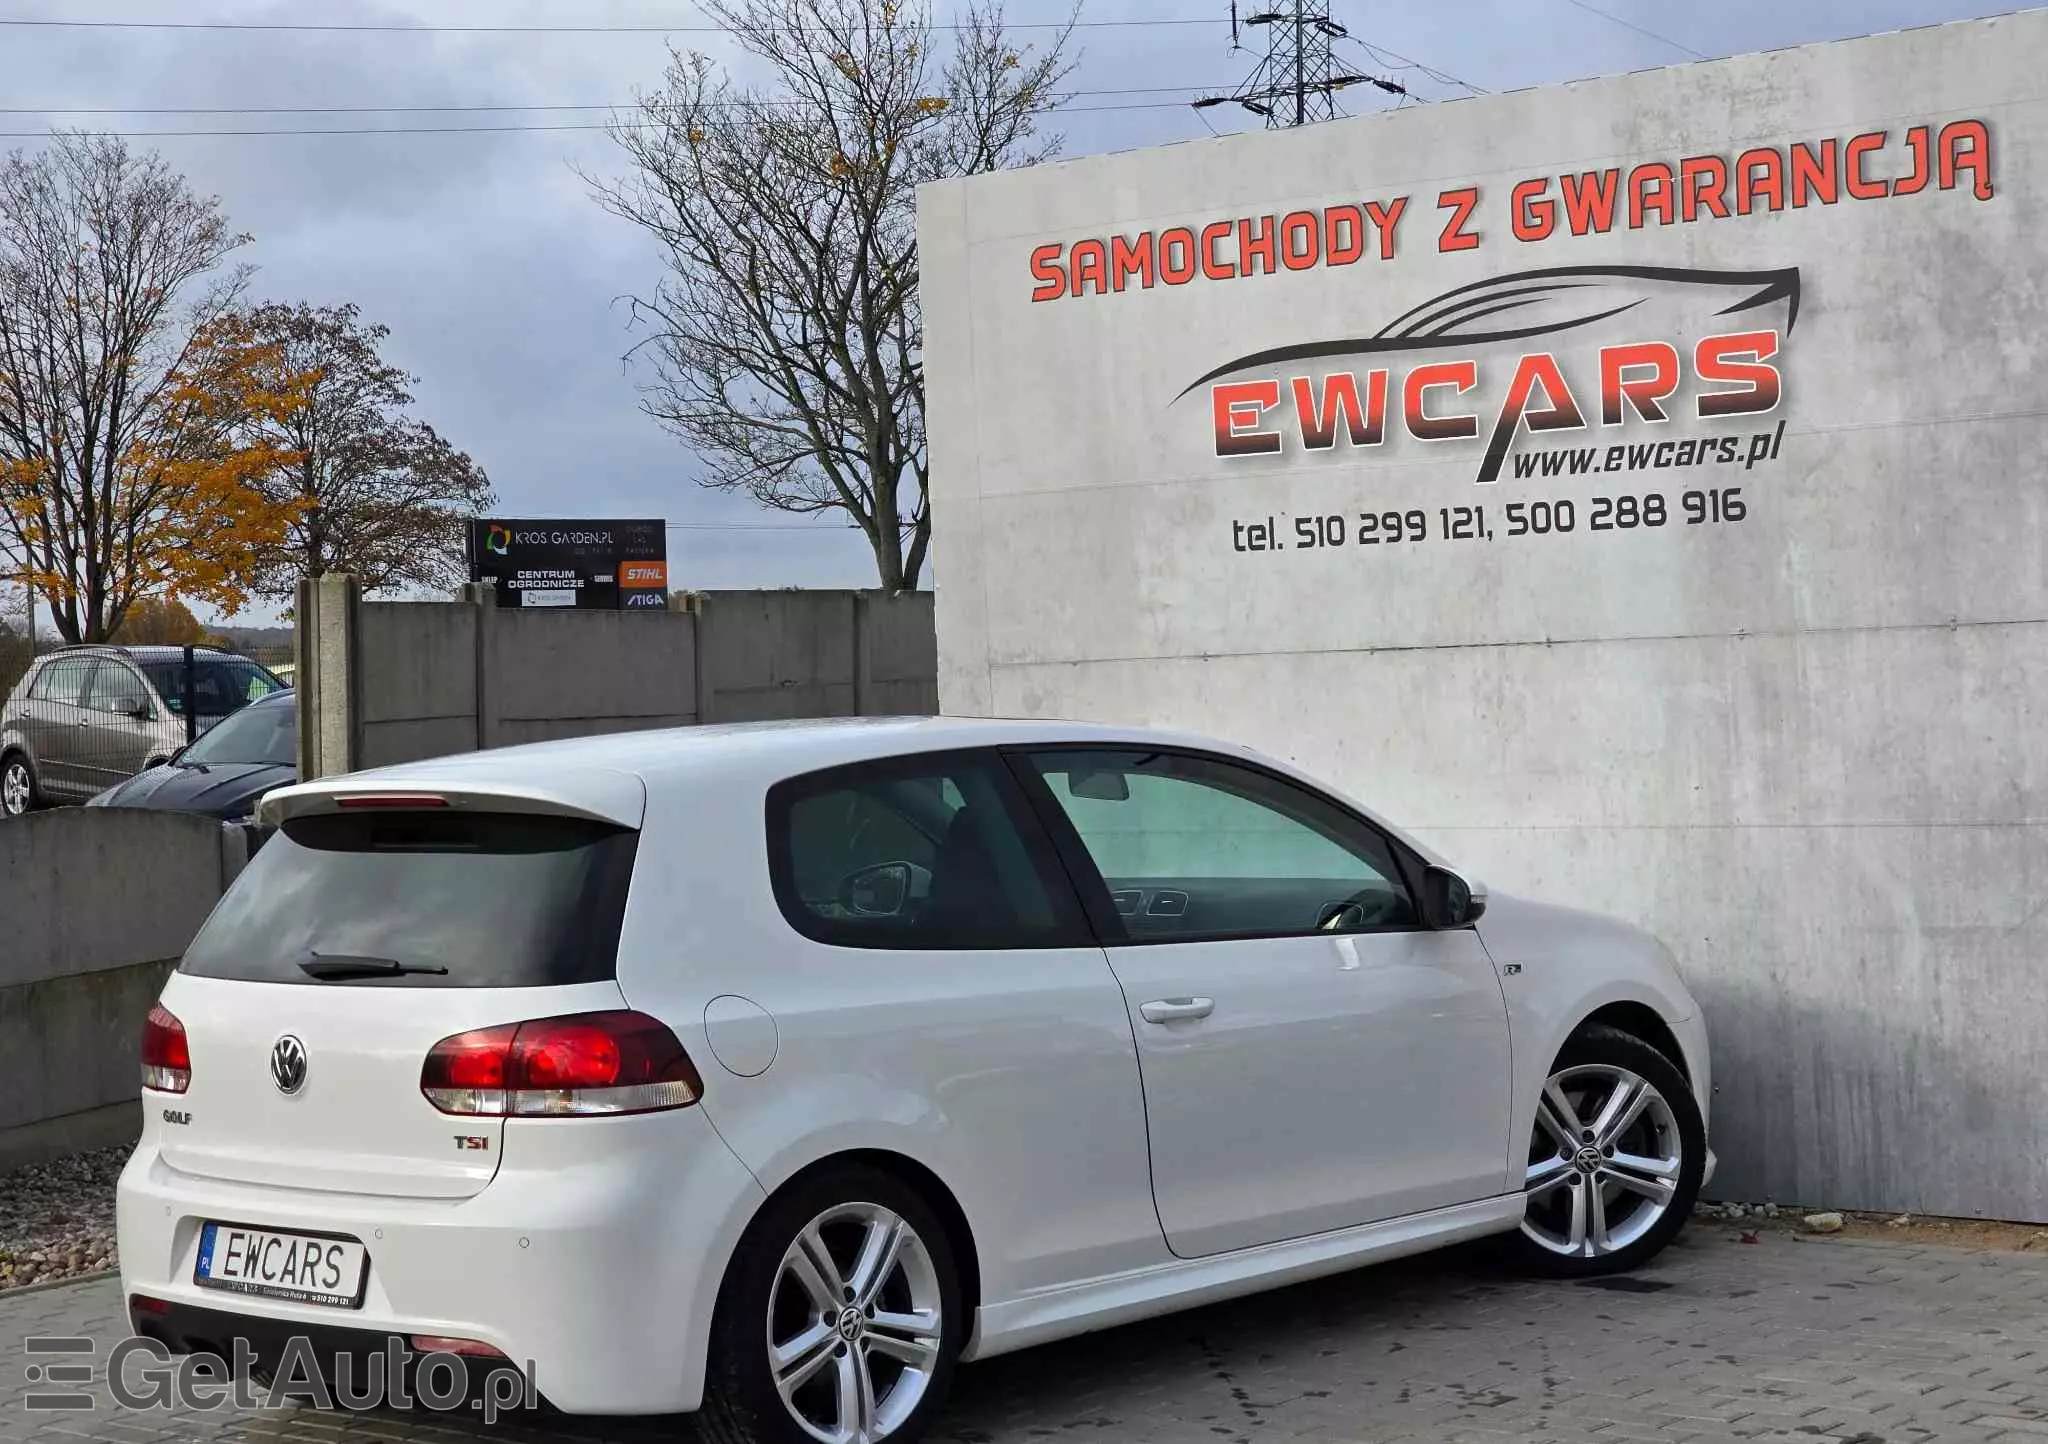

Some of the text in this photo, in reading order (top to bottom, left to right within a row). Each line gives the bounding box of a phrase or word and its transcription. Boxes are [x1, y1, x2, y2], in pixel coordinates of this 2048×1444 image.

[1030, 118, 1995, 303] SAMOCHODY Z GWARANCJĄ
[1211, 329, 1782, 484] EWCARS
[1513, 419, 1787, 480] www.ewcars.pl
[1232, 487, 1747, 552] tel. 510 299 121, 500 288 916
[515, 531, 614, 545] KROS GARDEN.PL
[517, 570, 576, 579] CENTRUM
[626, 567, 664, 581] STIHL
[507, 579, 585, 589] OGRODNICZE
[626, 594, 665, 606] STIGA
[162, 1108, 193, 1126] GOLF
[453, 1135, 489, 1151] TSI
[201, 1256, 210, 1270] PL
[223, 1231, 345, 1290] EWCARS
